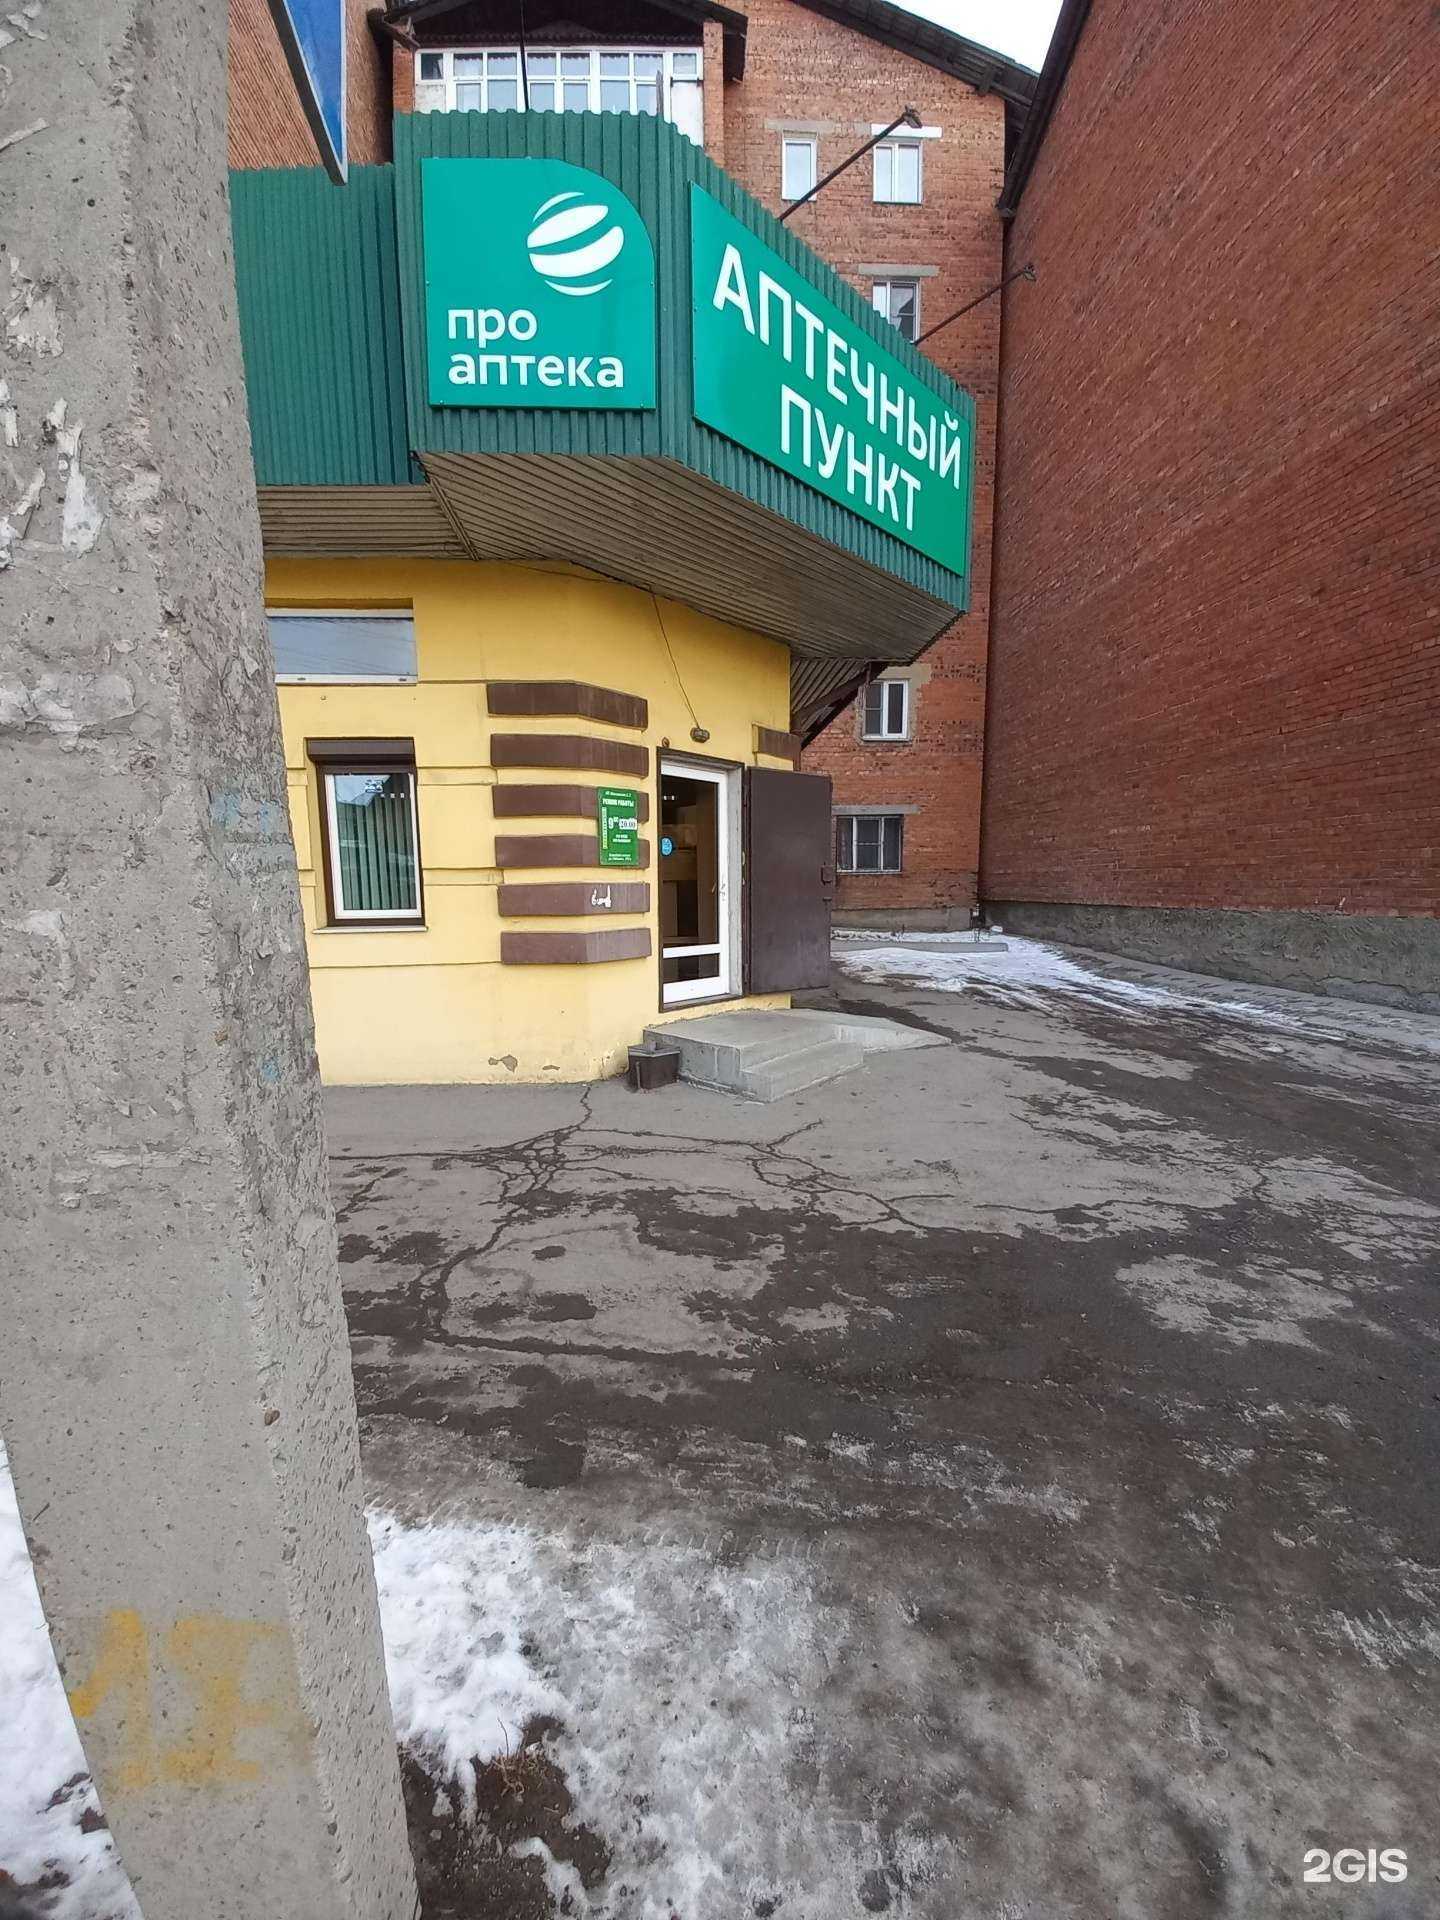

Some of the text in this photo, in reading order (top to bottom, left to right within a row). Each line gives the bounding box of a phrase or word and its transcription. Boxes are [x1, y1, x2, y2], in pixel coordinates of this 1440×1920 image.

[447, 308, 537, 348] про
[447, 353, 624, 388] аптека
[712, 243, 961, 489] АПТЕЧНЫЙ
[780, 384, 921, 531] ПУНКТ
